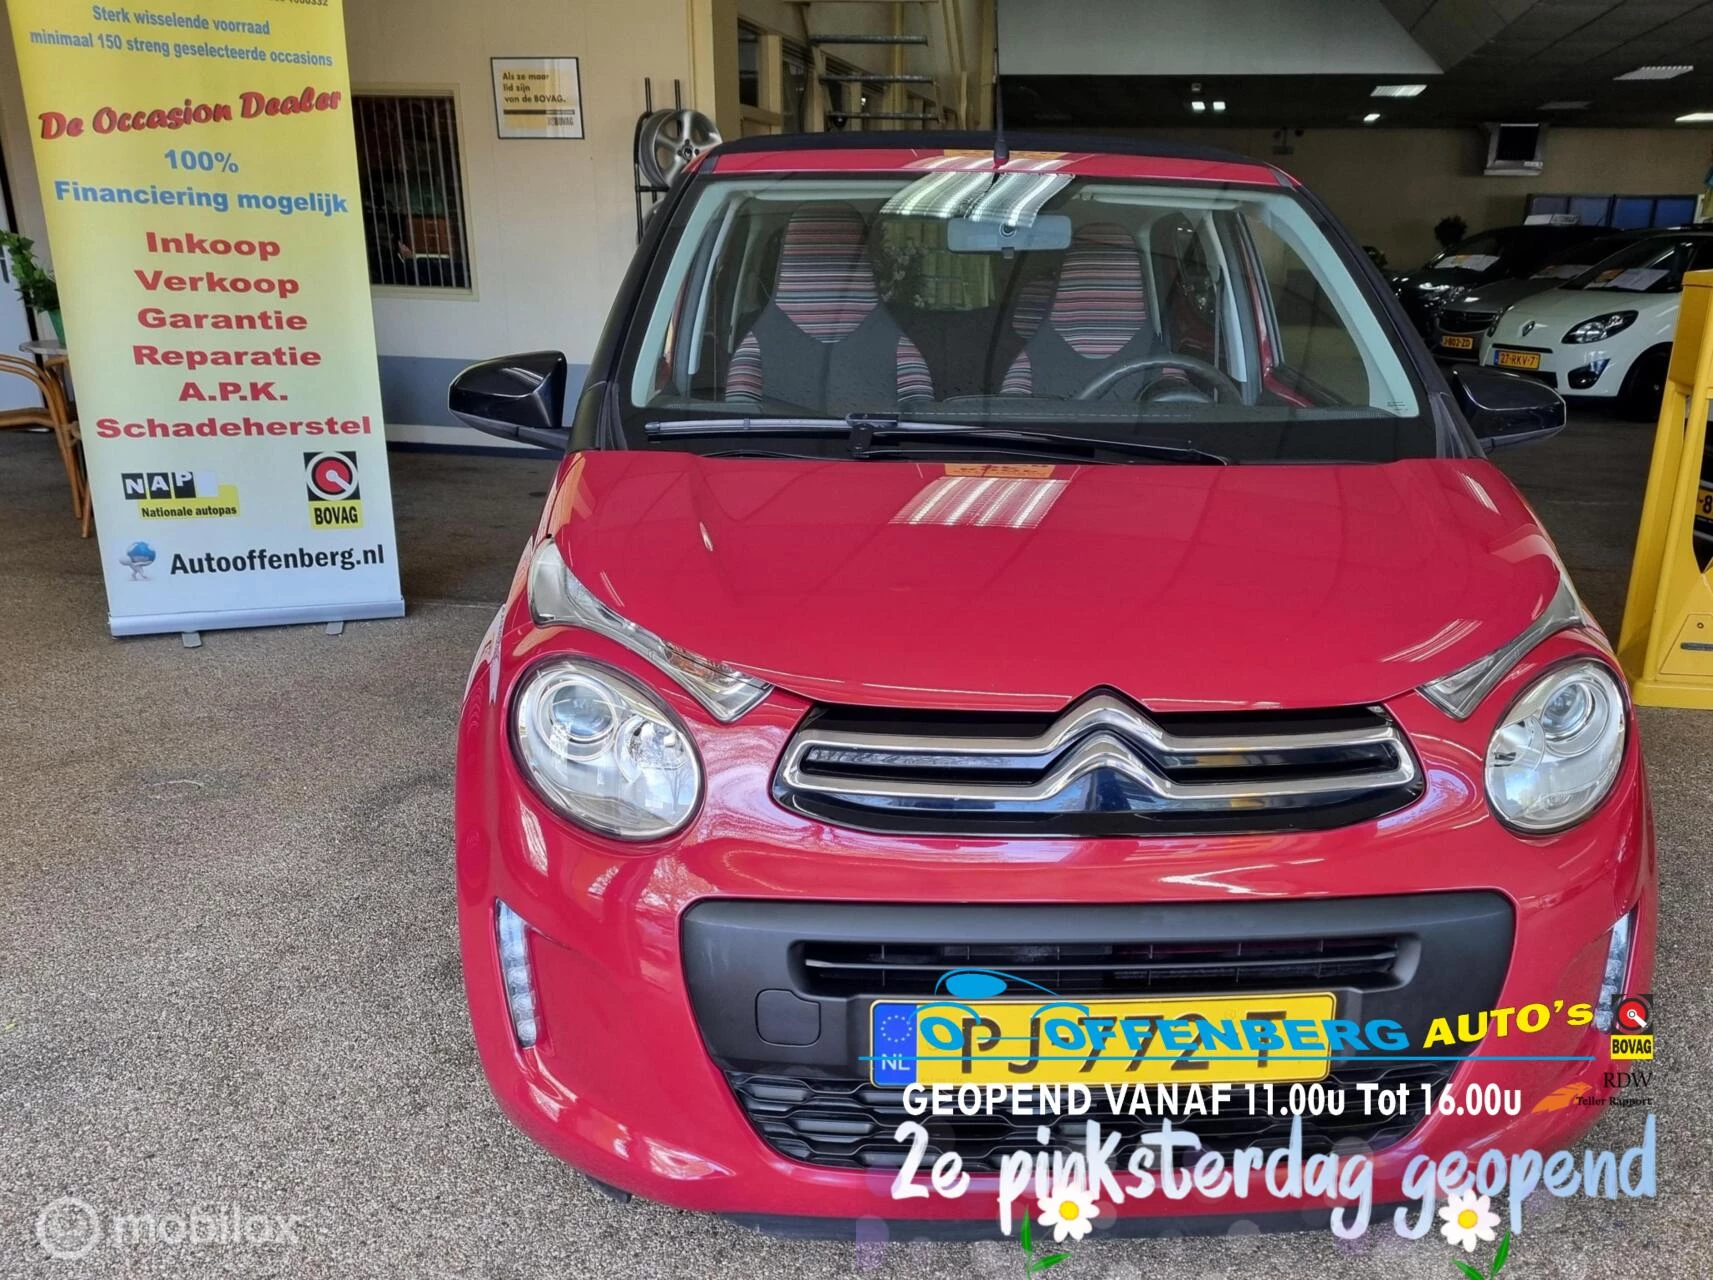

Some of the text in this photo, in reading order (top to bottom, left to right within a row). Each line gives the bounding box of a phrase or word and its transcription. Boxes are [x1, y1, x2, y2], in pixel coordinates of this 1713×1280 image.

[92, 6, 270, 35] Sterk wisselende voorraad
[30, 29, 333, 66] minimaal 150 streng geselecteerde occasions
[39, 87, 341, 139] De Occasion Dealer
[164, 149, 239, 173] 100%
[54, 180, 348, 216] Financiering mogelijk
[146, 232, 280, 261] Inkoop
[134, 269, 299, 298] Verkoop
[138, 308, 307, 330] Garantie
[133, 345, 321, 370] Reparatie
[179, 381, 288, 402] A.P.K.
[96, 416, 371, 439] Schadeherstel
[123, 471, 194, 495] NAP
[141, 505, 237, 518] Nationale autopas
[314, 505, 358, 526] BOVAG
[170, 545, 384, 575] Autooffenberg.nl
[881, 1053, 910, 1070] NL
